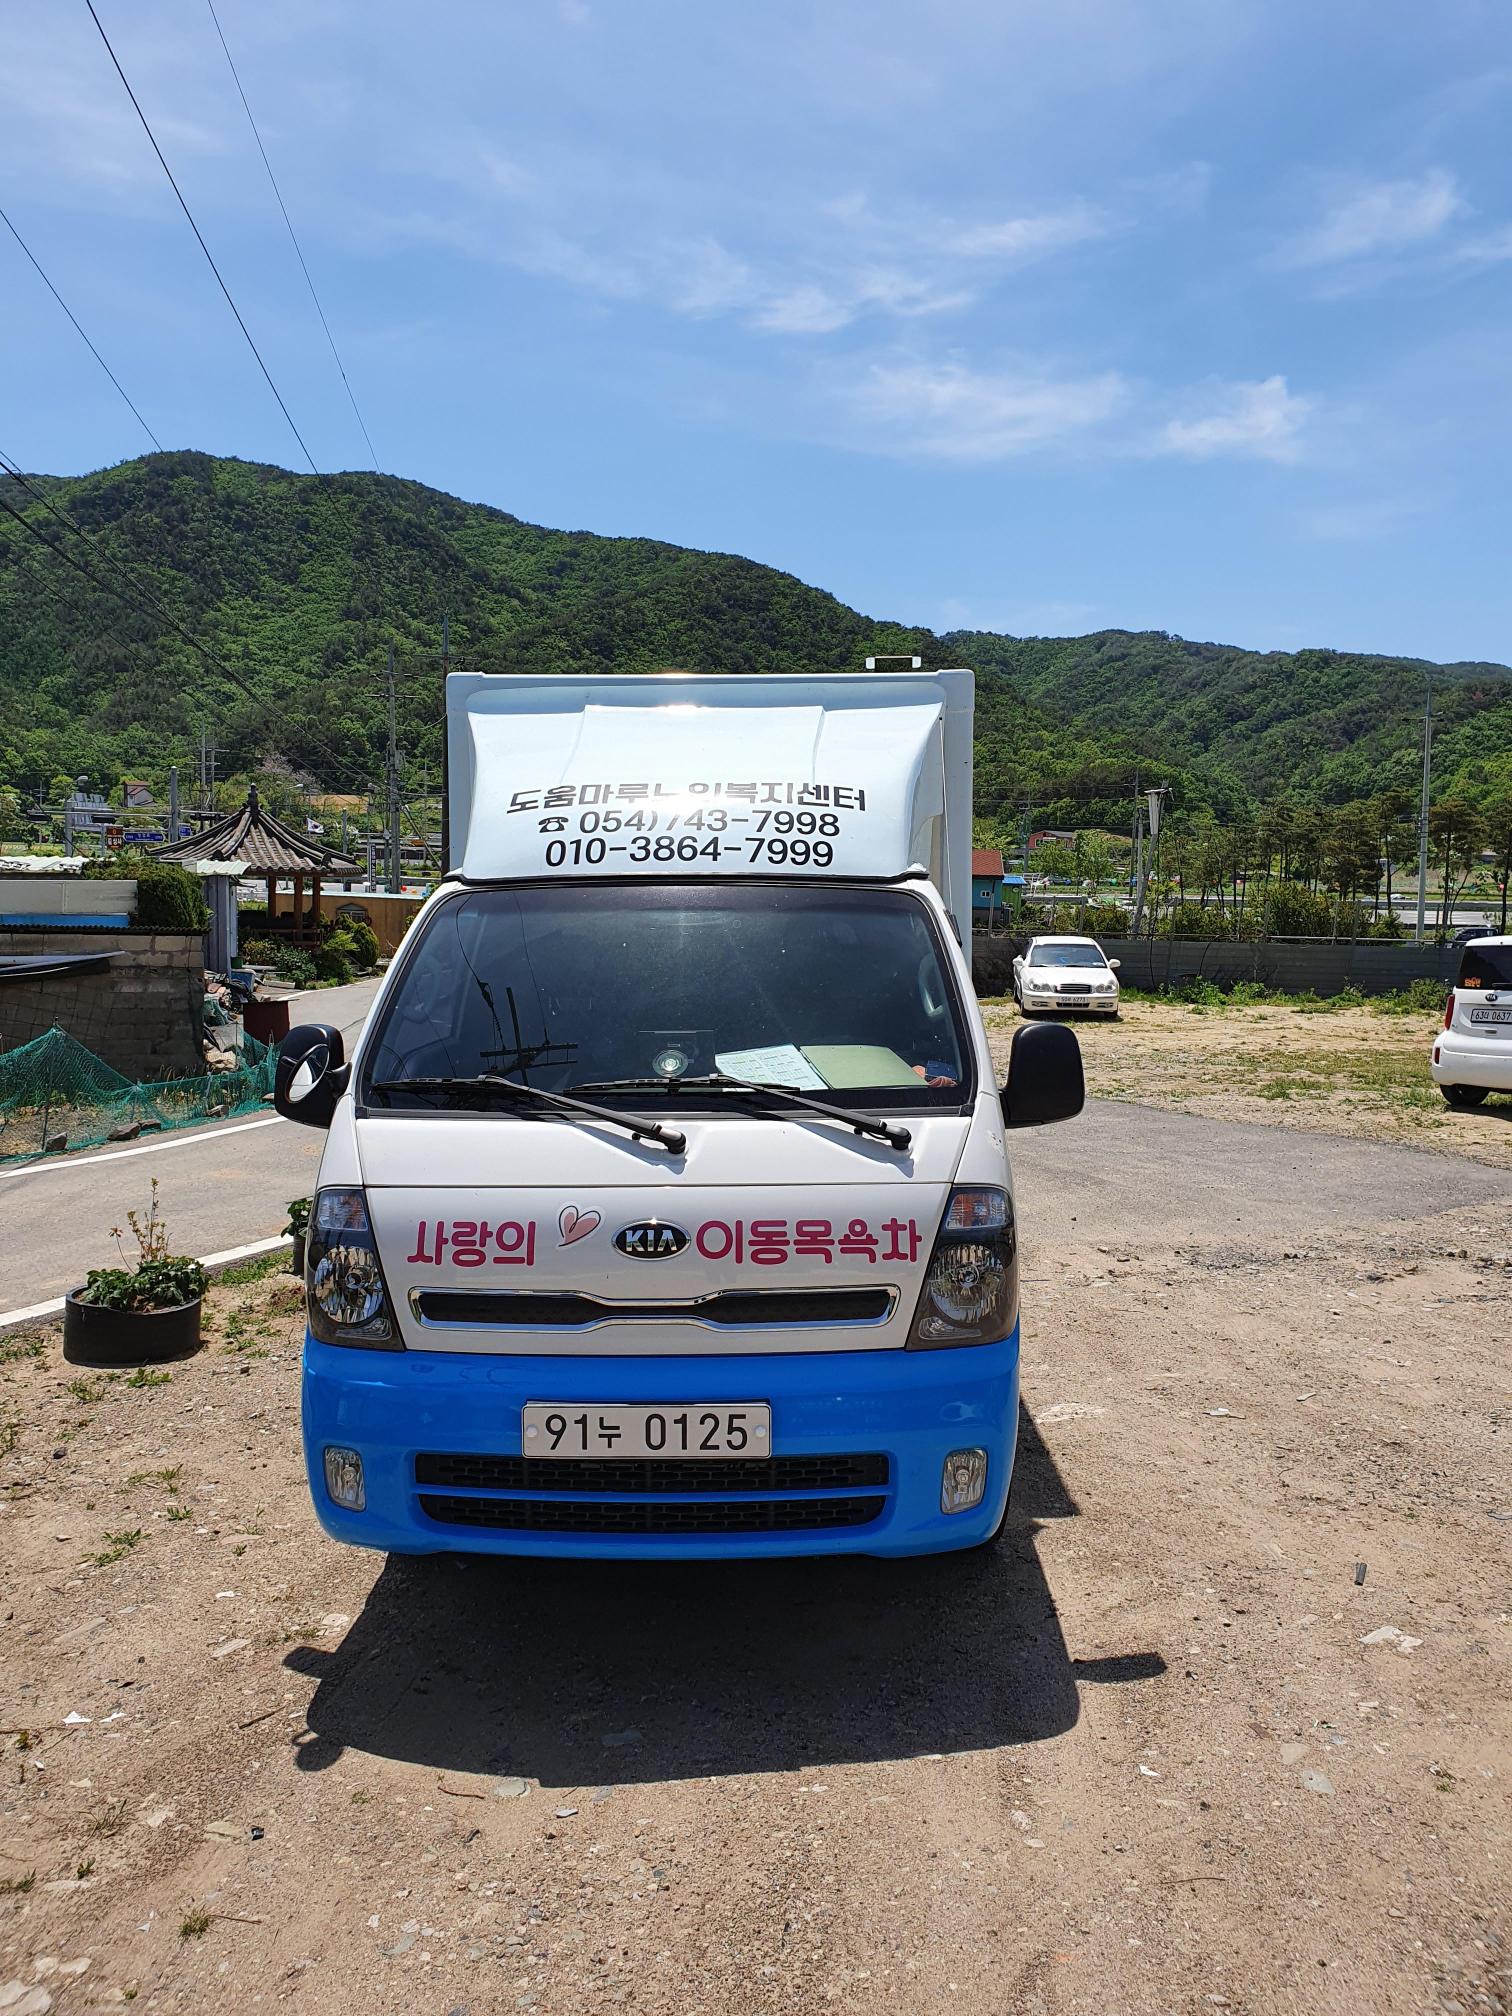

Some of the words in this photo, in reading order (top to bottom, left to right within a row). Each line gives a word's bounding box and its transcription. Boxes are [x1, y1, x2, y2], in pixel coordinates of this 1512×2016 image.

[545, 835, 833, 868] 010-3864-7999
[407, 1220, 536, 1267] 사랑의
[696, 1216, 923, 1265] 이동목욕차
[626, 1229, 678, 1252] KIA
[545, 1413, 622, 1450] 91누
[645, 1412, 748, 1450] 0125
